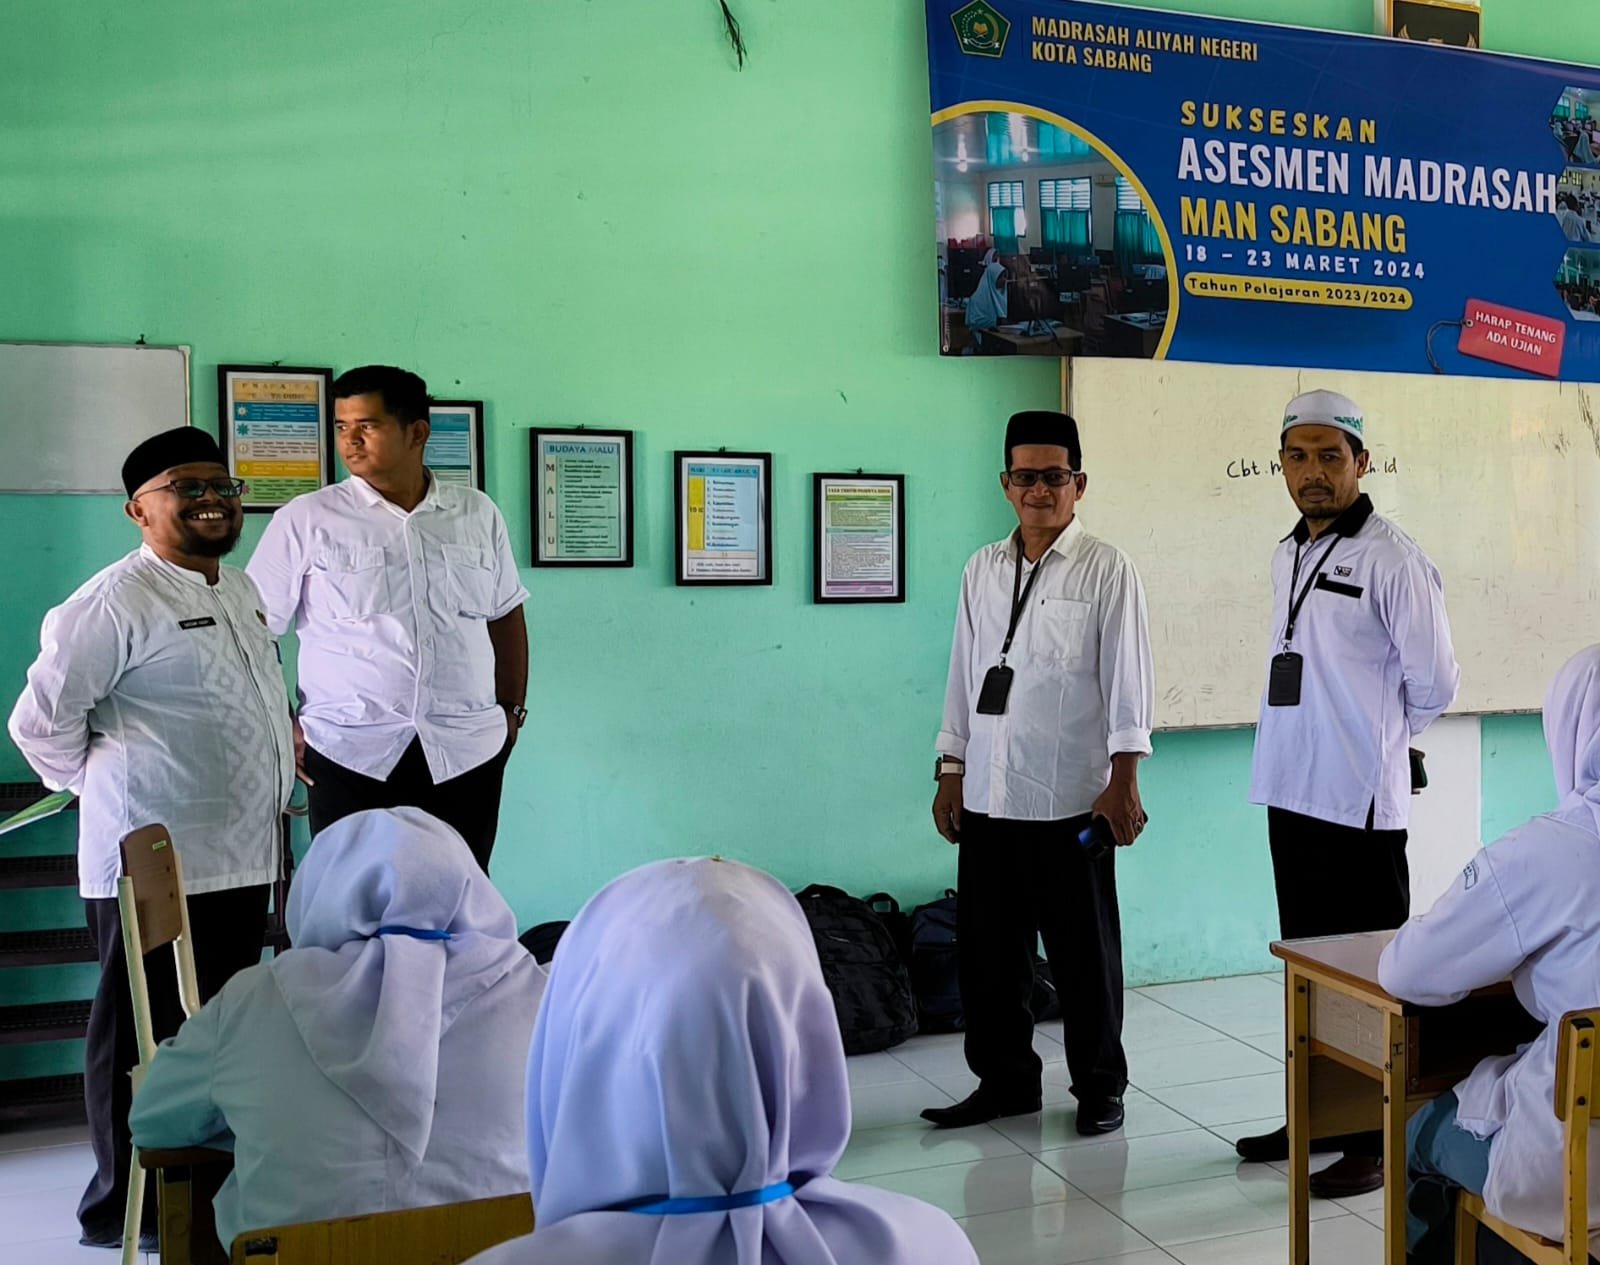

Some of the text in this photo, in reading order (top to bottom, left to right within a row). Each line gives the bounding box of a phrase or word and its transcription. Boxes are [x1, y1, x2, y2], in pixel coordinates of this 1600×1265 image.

[1032, 16, 1259, 62] MADRASAH ALIYAH NEGERI
[1032, 41, 1152, 73] KOTA SABANG
[1180, 100, 1377, 144] SUKSESKAN
[1177, 137, 1557, 214] ASESMEN MADRASAH
[1180, 196, 1407, 253] MAN SABANG
[1186, 244, 1207, 262] 18
[1247, 249, 1272, 267] 23
[1286, 252, 1360, 274] MARET
[1373, 259, 1425, 279] 2024
[1189, 277, 1406, 305] Tahun Pelajaran 2023/2024
[1475, 310, 1557, 344] HARAP TENANG
[1486, 331, 1542, 356] ADA UJIAN
[549, 445, 586, 454] BUDAYA
